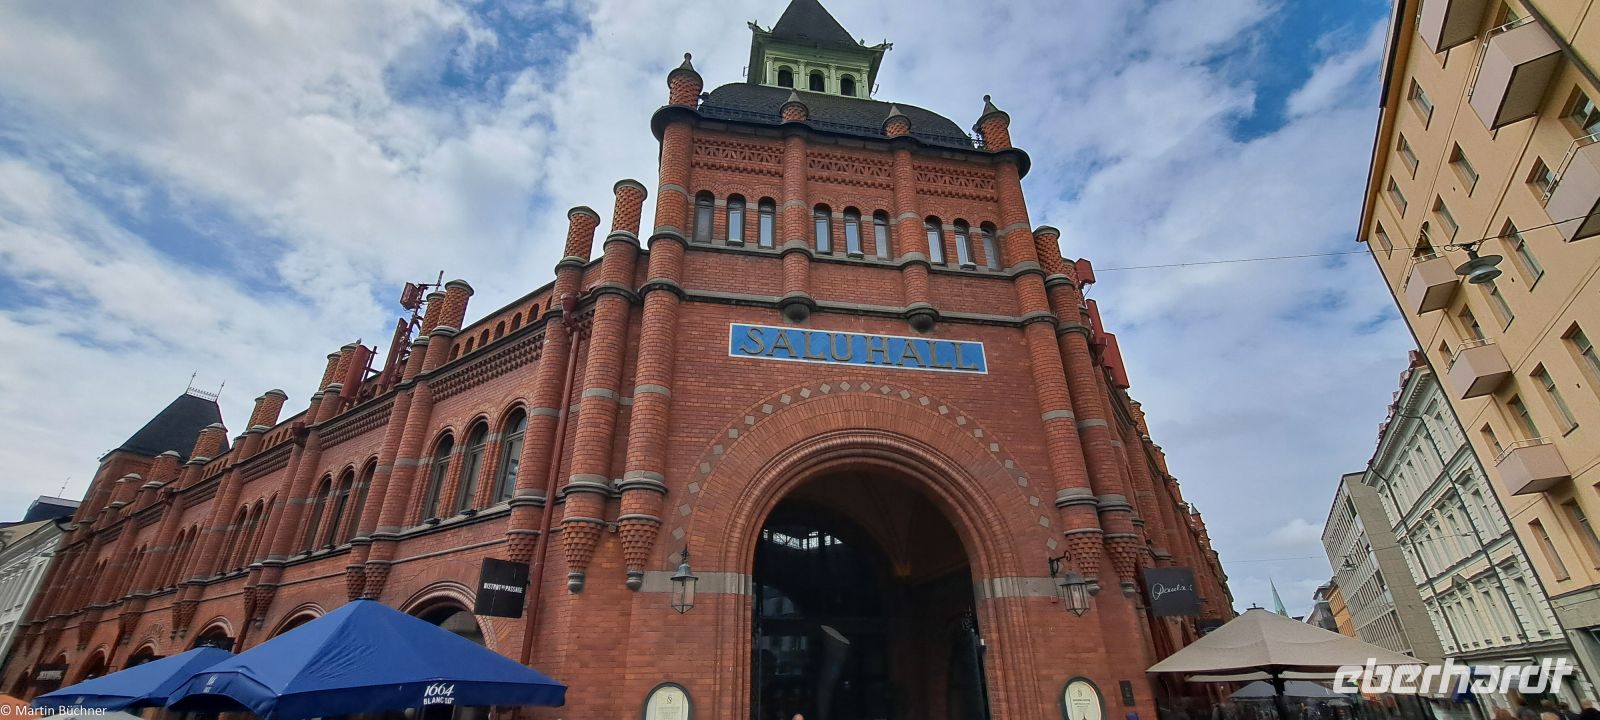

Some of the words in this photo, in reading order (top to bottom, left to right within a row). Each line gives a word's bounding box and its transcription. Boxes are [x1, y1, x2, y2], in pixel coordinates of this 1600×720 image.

[739, 327, 979, 370] SALUHALL
[423, 682, 455, 697] 1664
[423, 696, 445, 705] BLANC
